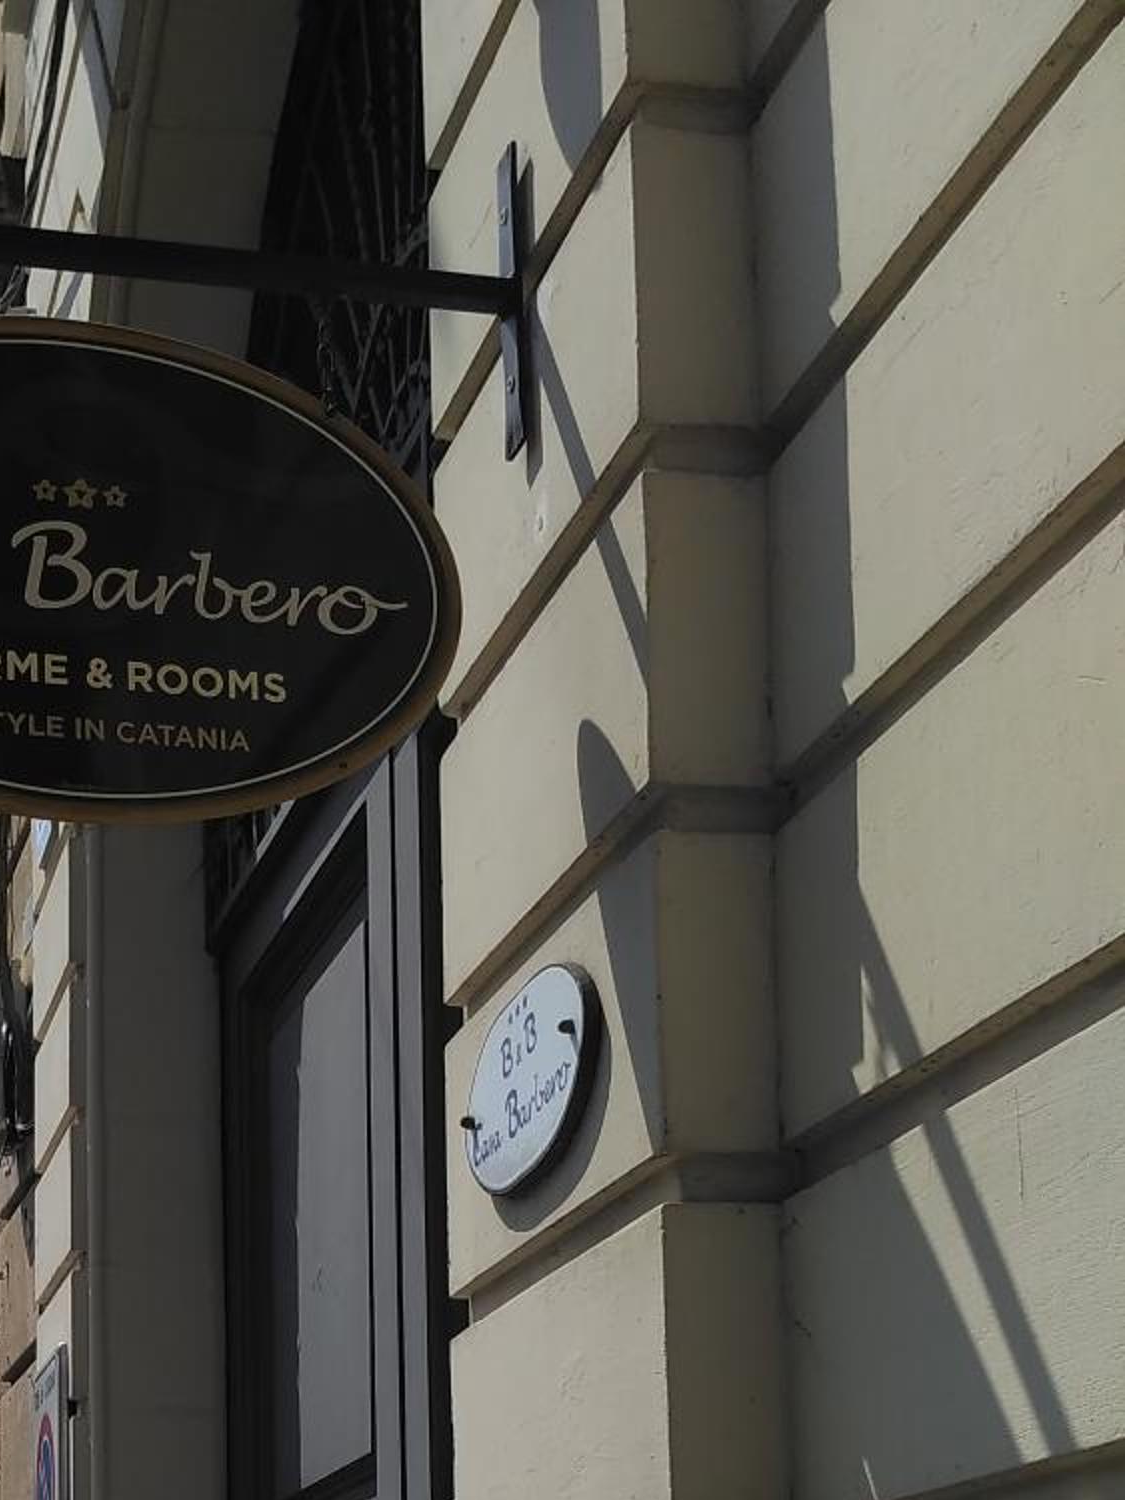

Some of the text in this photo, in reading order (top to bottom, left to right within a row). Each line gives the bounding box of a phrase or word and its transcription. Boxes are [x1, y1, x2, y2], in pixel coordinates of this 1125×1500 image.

[10, 520, 409, 636] Barbero
[85, 656, 113, 690] &
[127, 660, 287, 703] ROOMS
[75, 717, 105, 741] IN
[116, 720, 251, 752] CATANIA
[504, 1060, 572, 1139] Barbero
